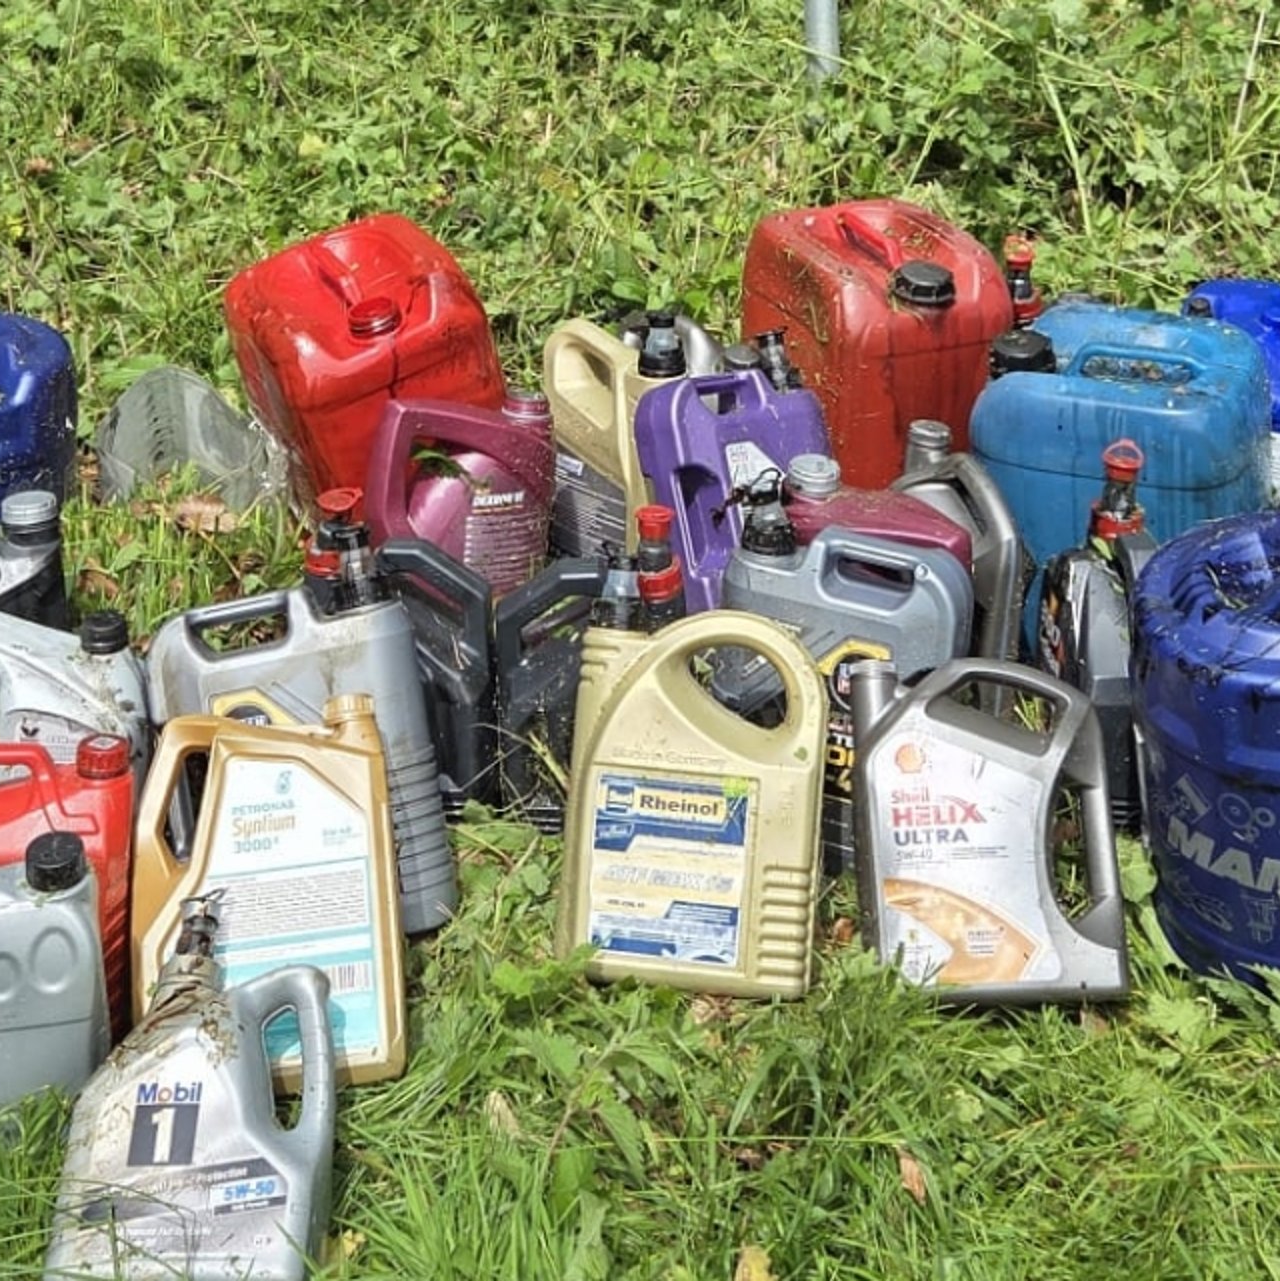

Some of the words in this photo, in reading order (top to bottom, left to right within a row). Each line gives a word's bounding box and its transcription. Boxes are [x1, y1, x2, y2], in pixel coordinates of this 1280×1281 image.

[891, 784, 930, 804] Shell
[231, 800, 295, 815] PETRONAS
[640, 794, 718, 816] Rheinol
[891, 803, 987, 828] HELIX
[232, 814, 296, 839] Syntium
[893, 829, 969, 847] ULTRA
[136, 1082, 202, 1103] Mobil
[151, 1107, 176, 1164] 1
[223, 1180, 276, 1201] 5W-50
